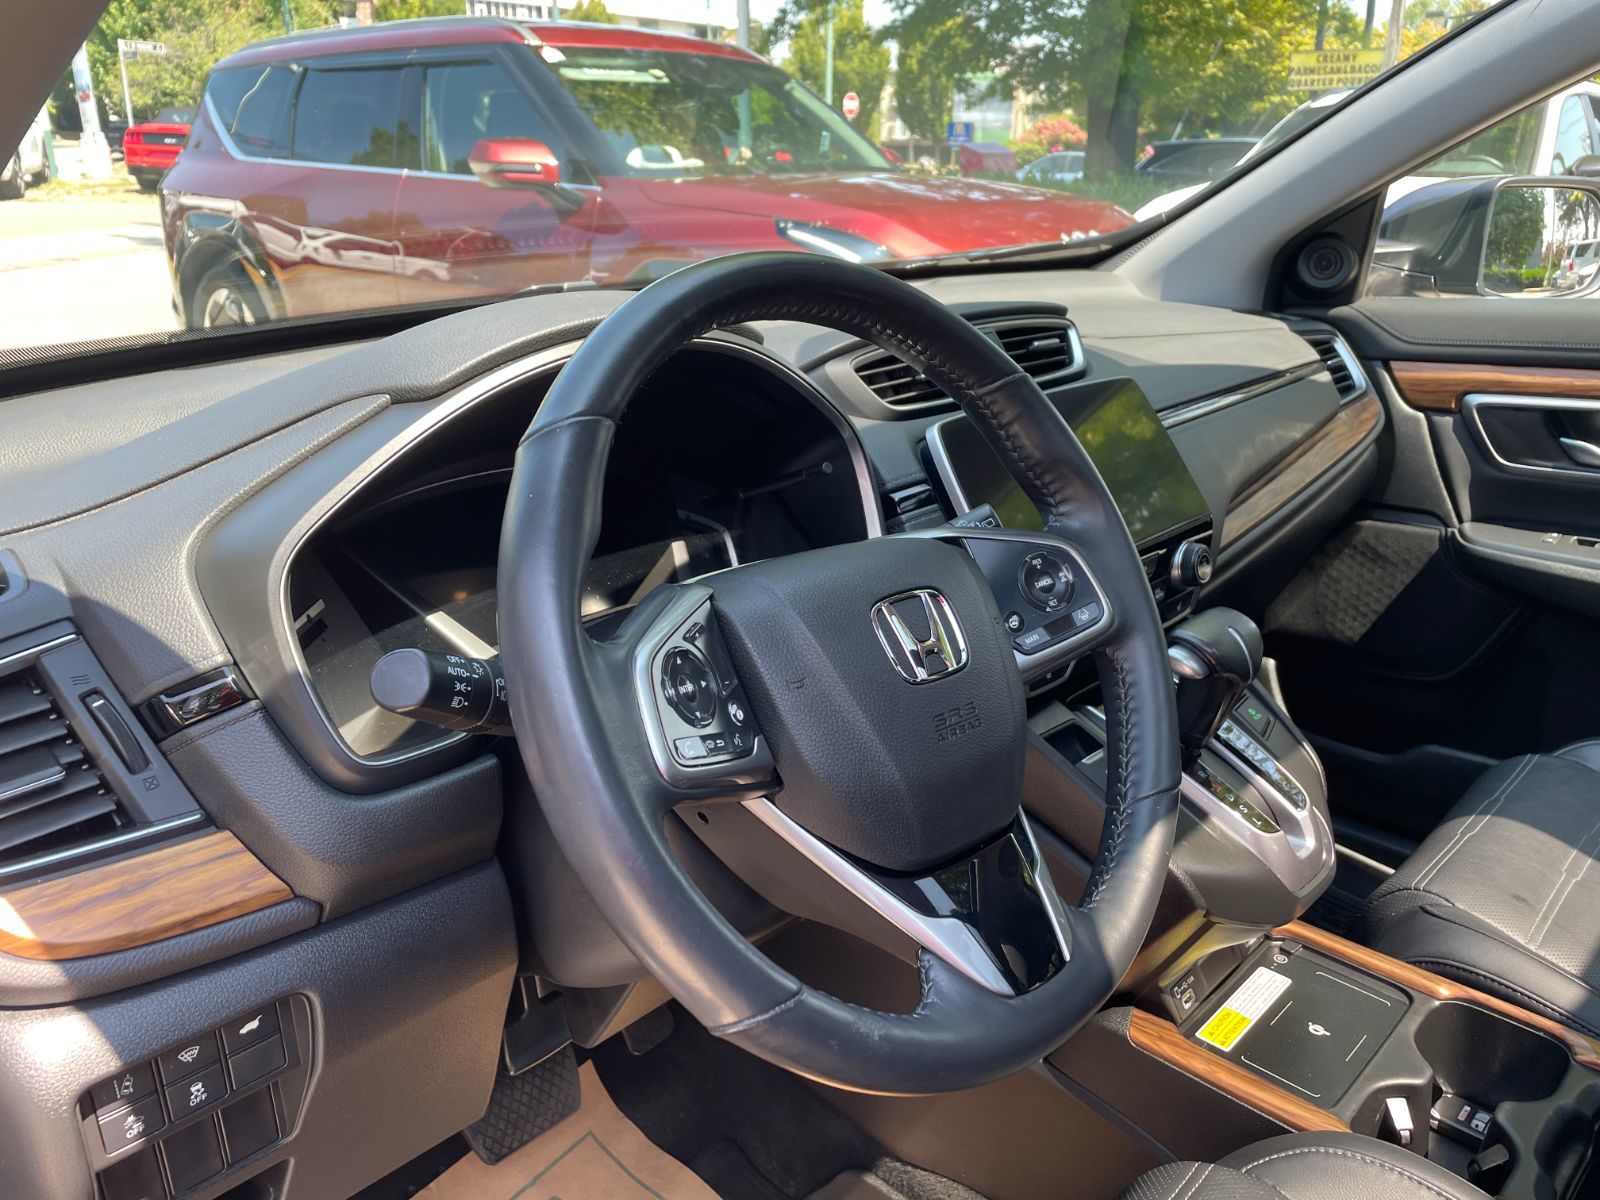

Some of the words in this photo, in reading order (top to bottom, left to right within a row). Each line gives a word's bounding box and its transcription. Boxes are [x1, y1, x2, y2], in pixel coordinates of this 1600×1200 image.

[1316, 52, 1358, 63] CREAMY
[1034, 578, 1054, 588] CANCEL
[1047, 599, 1058, 607] SET
[1025, 634, 1040, 644] MAIN
[446, 655, 461, 663] OFF
[448, 667, 467, 677] AUTO
[678, 683, 695, 694] ENTER
[933, 701, 978, 729] SRS
[938, 717, 982, 743] AIRBAG
[1211, 1012, 1233, 1031] CAUTION
[1223, 1017, 1249, 1041] ATTENTION
[190, 1092, 207, 1106] OFF
[126, 1124, 145, 1139] OFF
